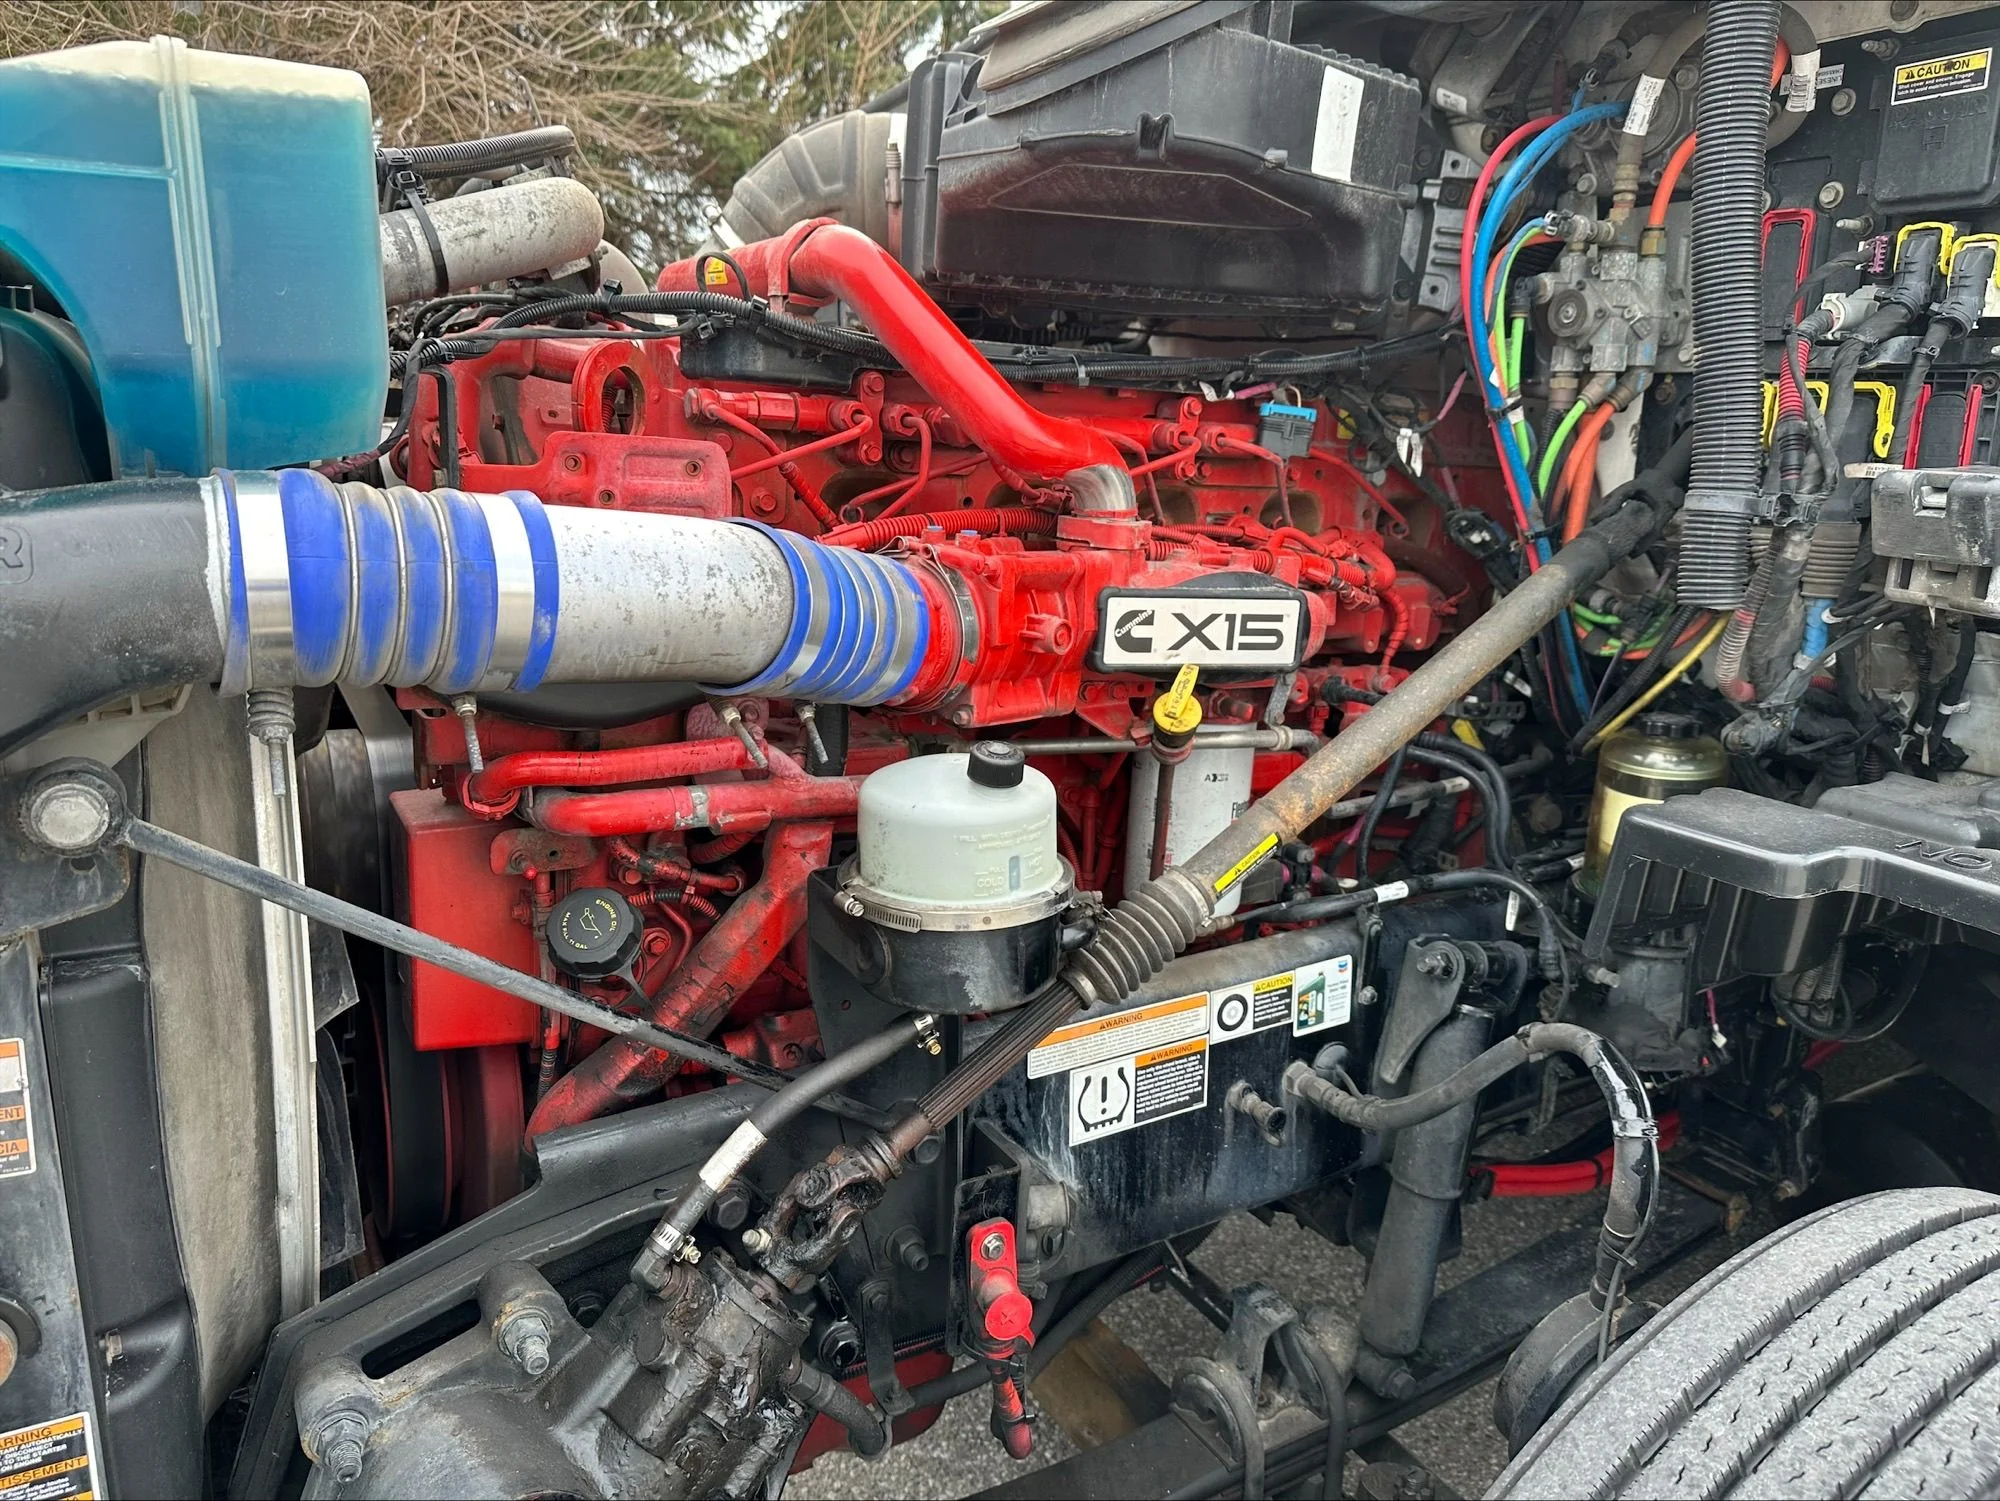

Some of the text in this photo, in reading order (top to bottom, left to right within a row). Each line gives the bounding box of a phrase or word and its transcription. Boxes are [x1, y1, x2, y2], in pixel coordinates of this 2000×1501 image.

[1917, 59, 1970, 77] CAUTON
[1114, 609, 1153, 638] Cummins
[1166, 613, 1284, 651] X15
[596, 899, 617, 918] ENGINE
[1260, 976, 1292, 990] CAUTION
[1105, 1013, 1142, 1028] WARNING
[1157, 1045, 1192, 1059] WARNING
